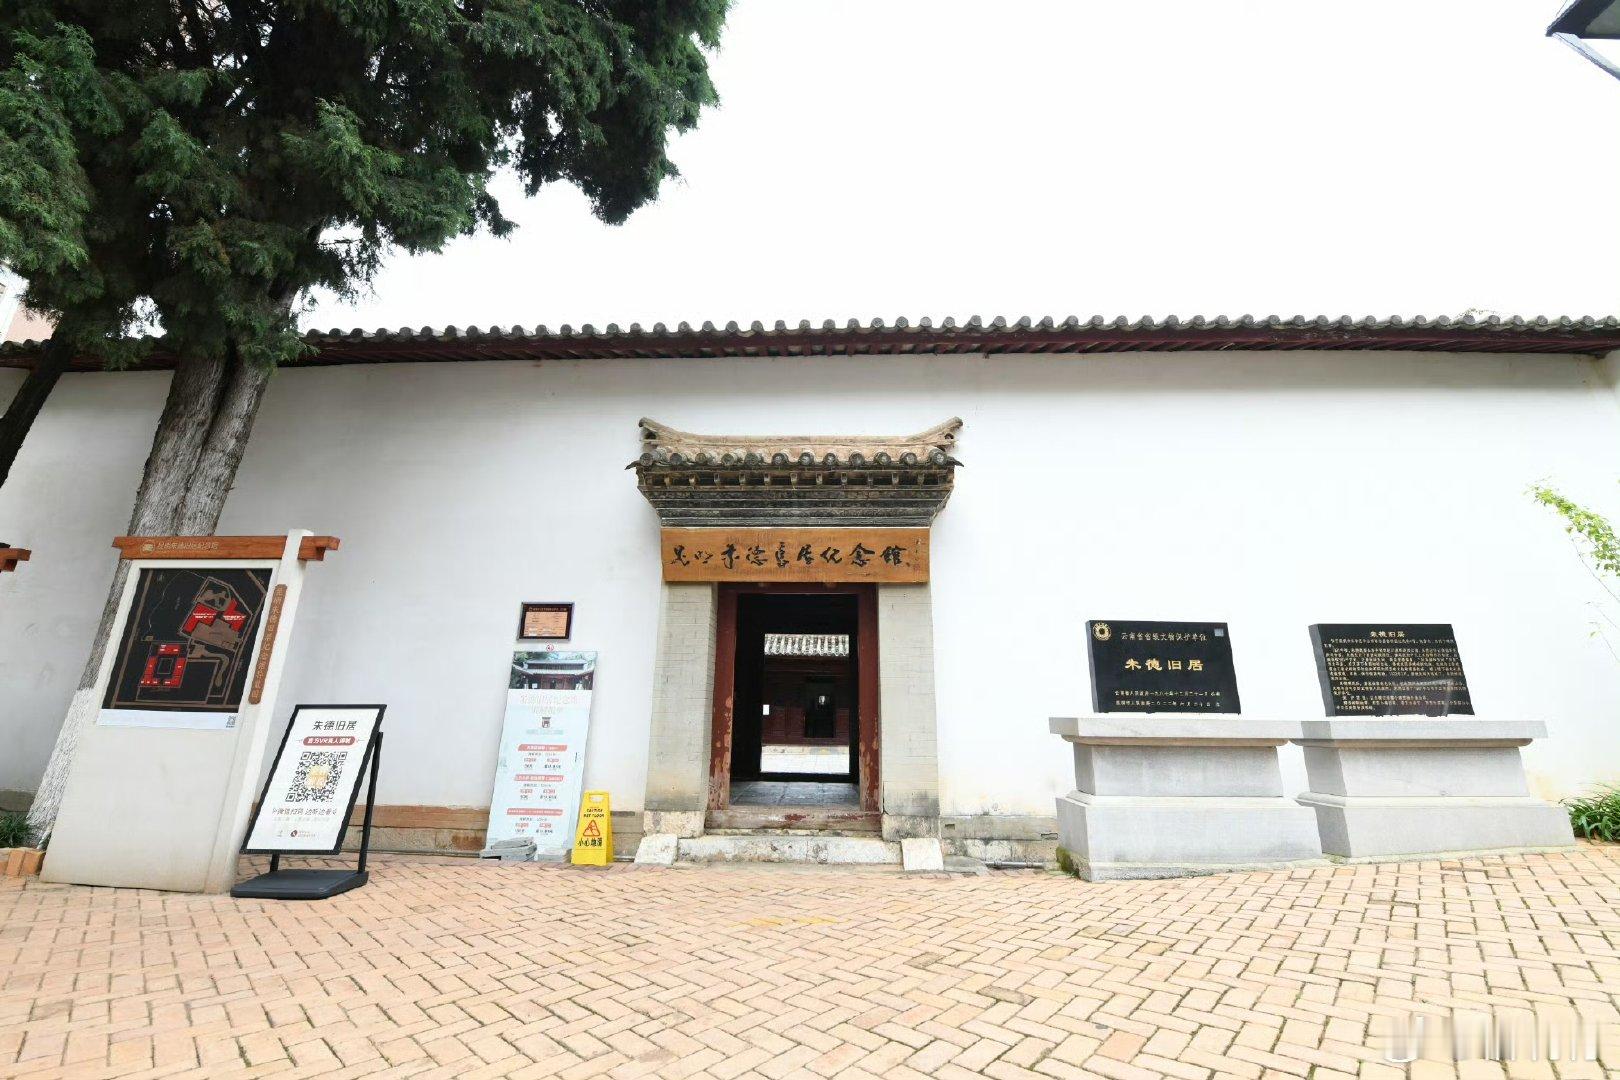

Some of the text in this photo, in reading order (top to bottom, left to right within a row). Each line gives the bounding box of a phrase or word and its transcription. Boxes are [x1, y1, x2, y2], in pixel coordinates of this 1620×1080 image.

[1124, 657, 1204, 671] 朱德旧居
[312, 720, 357, 731] 朱德旧居
[578, 837, 603, 847] 小心地滑
